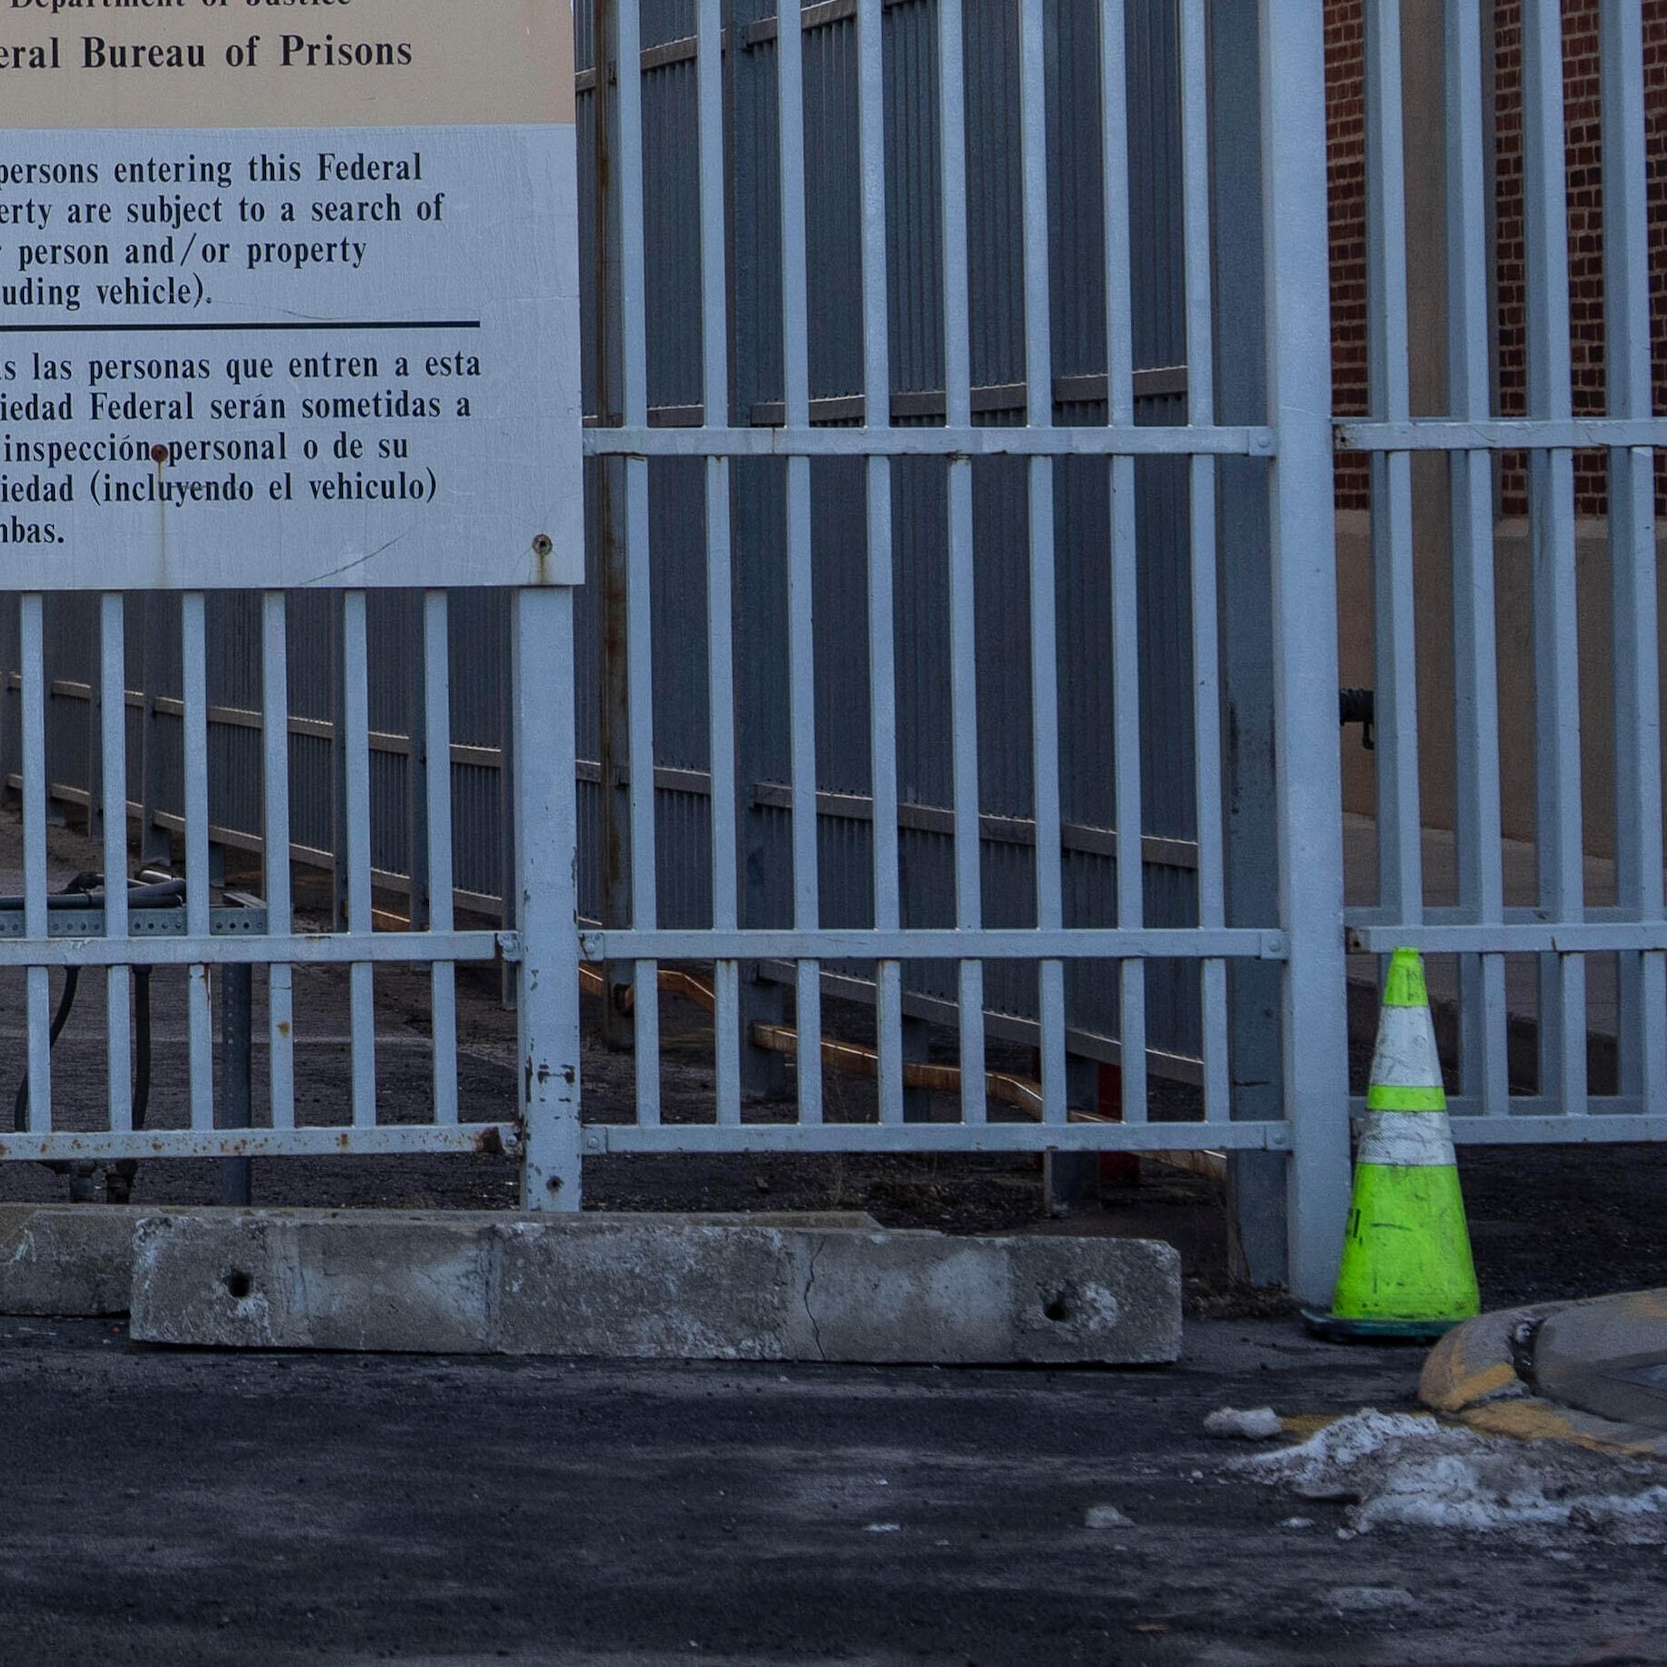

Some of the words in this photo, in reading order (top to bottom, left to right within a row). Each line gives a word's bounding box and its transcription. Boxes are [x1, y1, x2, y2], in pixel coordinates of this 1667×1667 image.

[80, 36, 206, 69] Bureau
[225, 34, 261, 68] of
[279, 34, 412, 67] Prisons
[114, 153, 232, 189] entering
[248, 153, 301, 182] this
[317, 152, 422, 182] Federal
[67, 203, 112, 224] are
[126, 194, 223, 230] subject
[238, 196, 265, 223] to
[280, 202, 296, 223] a
[311, 192, 402, 223] search
[416, 192, 446, 222] of
[18, 244, 109, 272] person
[125, 232, 231, 267] and/or
[246, 236, 367, 270] property
[95, 272, 212, 309] vehicle).
[32, 352, 72, 381] las
[88, 358, 210, 387] personas
[226, 358, 274, 386] que
[288, 351, 379, 378] entren
[394, 356, 410, 377] a
[425, 350, 482, 377] esta
[89, 391, 194, 421] Federal
[210, 393, 286, 420] serán
[301, 389, 441, 419] sometidas
[456, 397, 472, 417] a
[4, 431, 152, 469] inspección
[167, 431, 287, 469] personal
[303, 439, 318, 460] o
[333, 430, 364, 459] de
[378, 438, 408, 459] su
[90, 470, 254, 508] (incluyendo
[269, 472, 293, 501] el
[308, 466, 437, 504] vehiculo)
